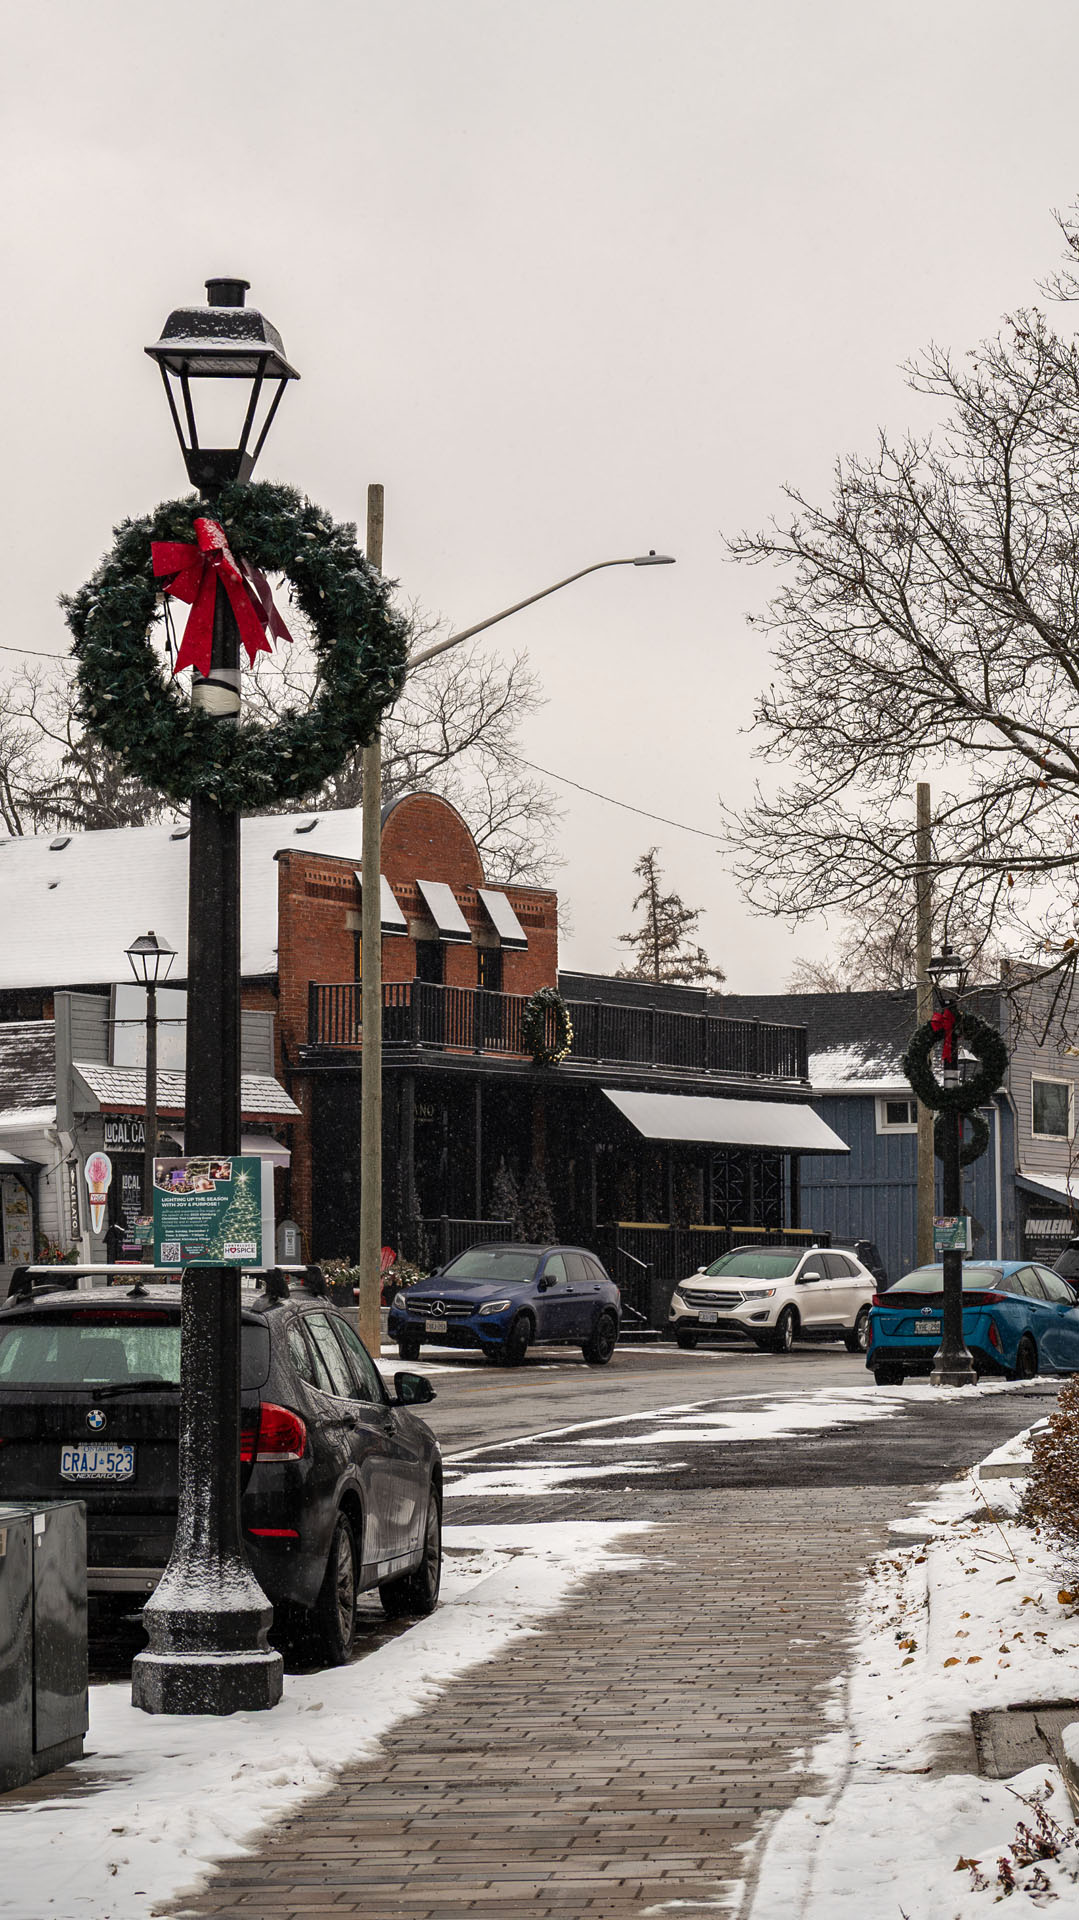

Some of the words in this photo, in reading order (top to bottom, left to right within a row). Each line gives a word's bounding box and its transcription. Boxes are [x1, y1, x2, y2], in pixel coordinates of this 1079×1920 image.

[105, 1123, 130, 1143] LOCAL
[122, 1175, 140, 1190] LOCAL
[70, 1186, 78, 1229] GELATO
